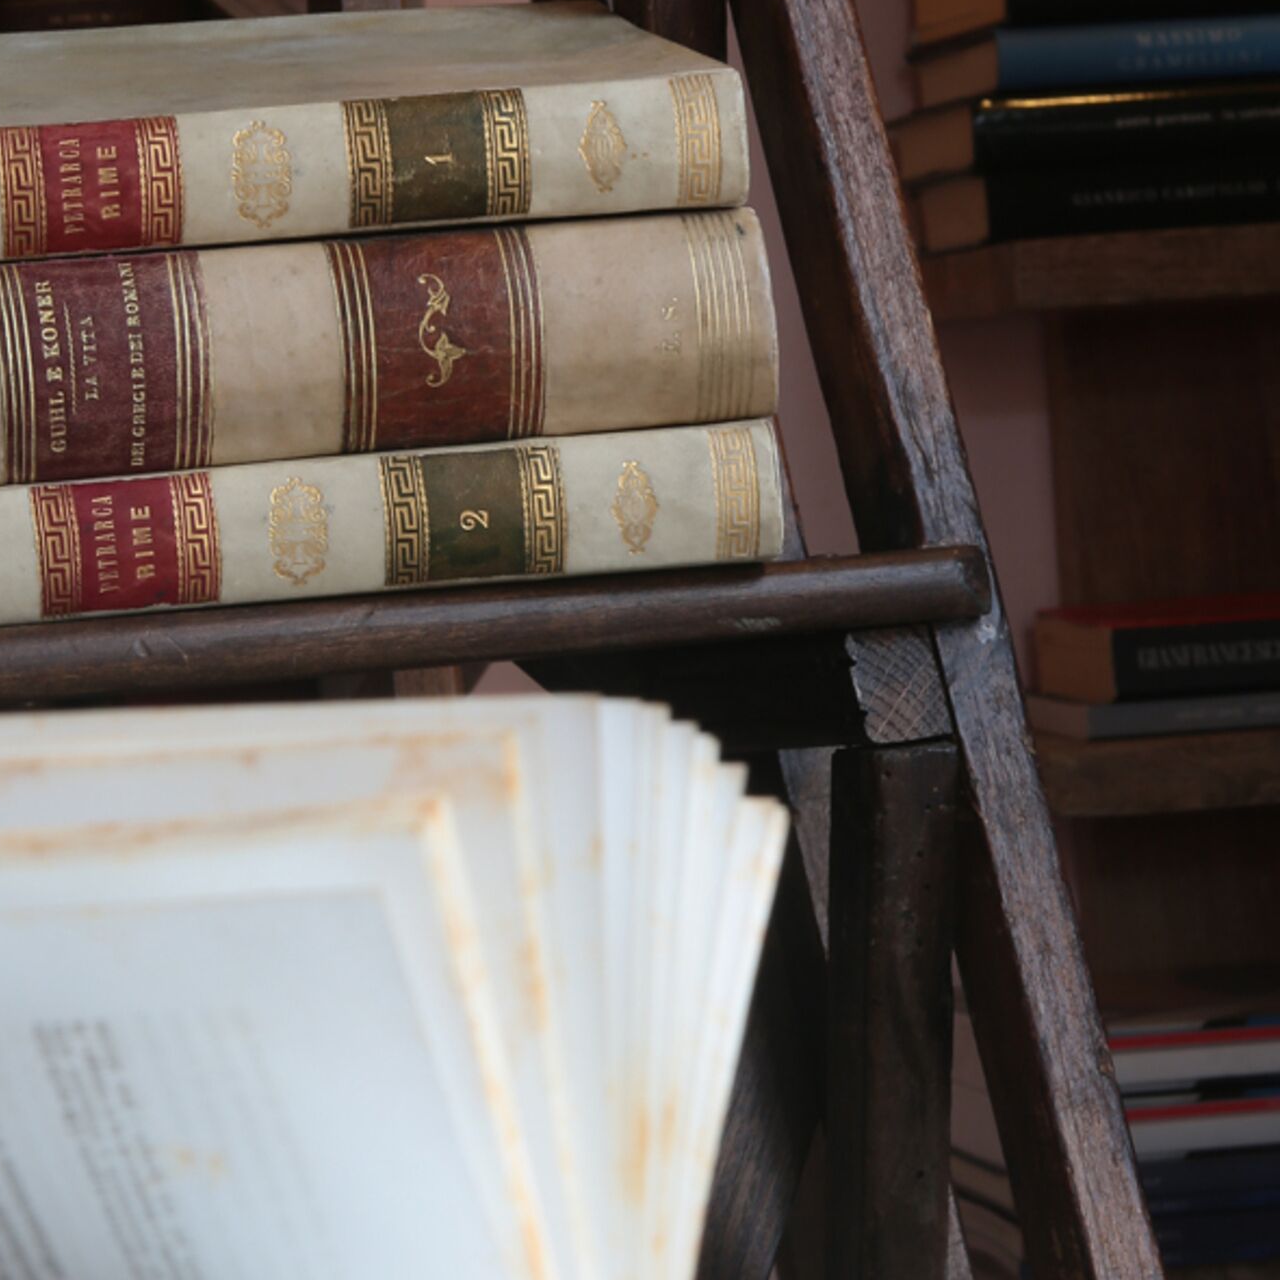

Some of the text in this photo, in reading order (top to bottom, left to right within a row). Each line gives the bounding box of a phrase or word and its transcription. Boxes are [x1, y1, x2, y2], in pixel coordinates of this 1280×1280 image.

[59, 138, 85, 236] PETRARCA
[96, 145, 121, 221] RIME
[35, 280, 67, 454] GUHL E KONER
[79, 316, 100, 401] LA VITA
[117, 262, 146, 467] DEI GRECI E DEI ROMANI
[91, 494, 120, 594] PETRARCA
[130, 505, 156, 580] RIME
[459, 509, 489, 532] 2
